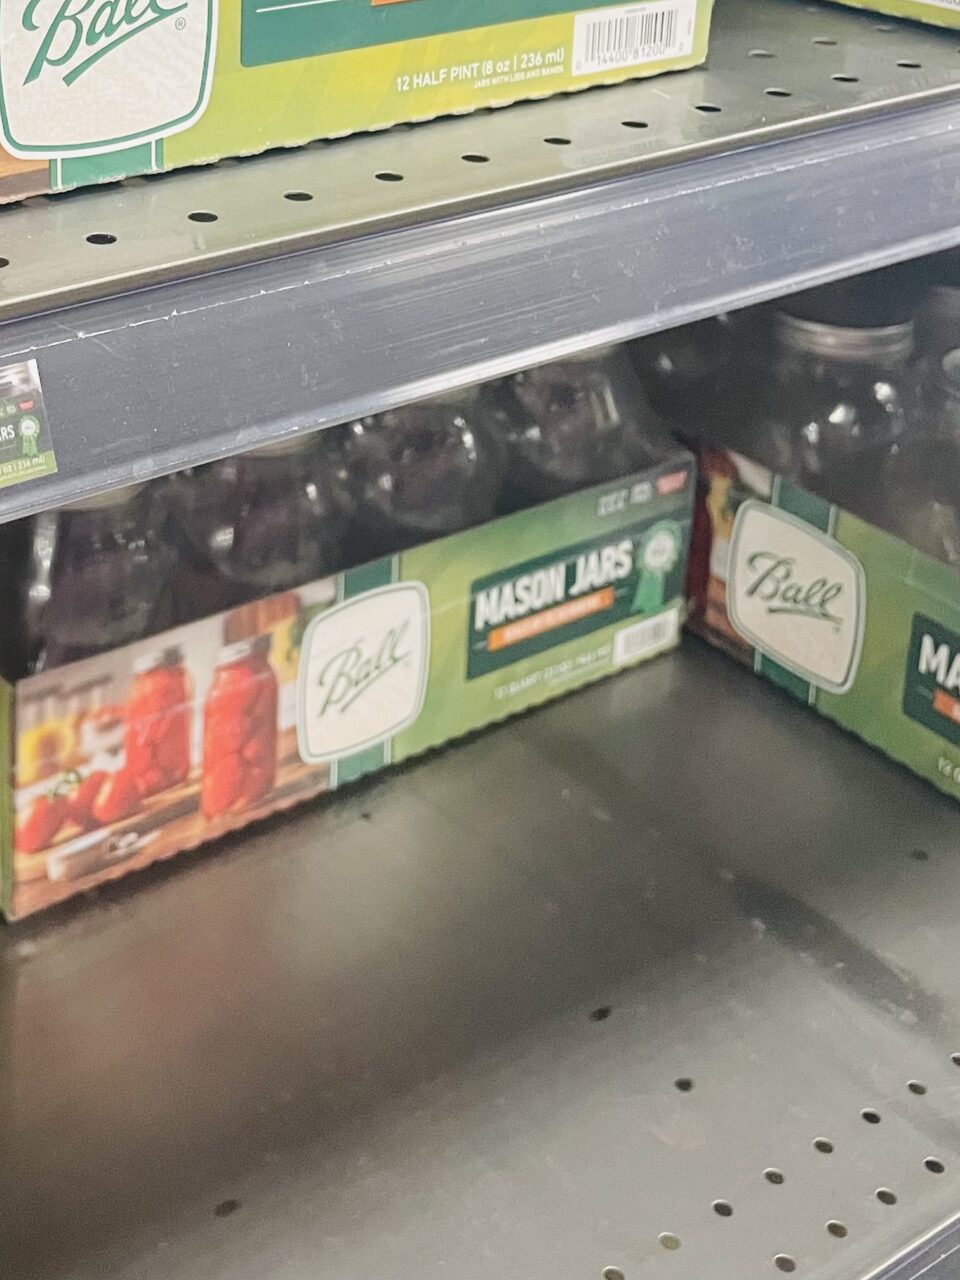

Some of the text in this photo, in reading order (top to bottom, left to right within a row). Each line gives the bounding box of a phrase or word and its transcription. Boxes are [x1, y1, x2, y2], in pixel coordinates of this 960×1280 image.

[396, 74, 410, 92] 12
[413, 68, 448, 89] HALF
[451, 62, 480, 83] PINT
[482, 60, 494, 77] (8
[496, 59, 510, 73] oz
[520, 53, 543, 70] 236
[596, 43, 666, 67] 14400 81200
[474, 562, 567, 631] MASON
[569, 539, 634, 595] JARS
[746, 551, 844, 624] Ball
